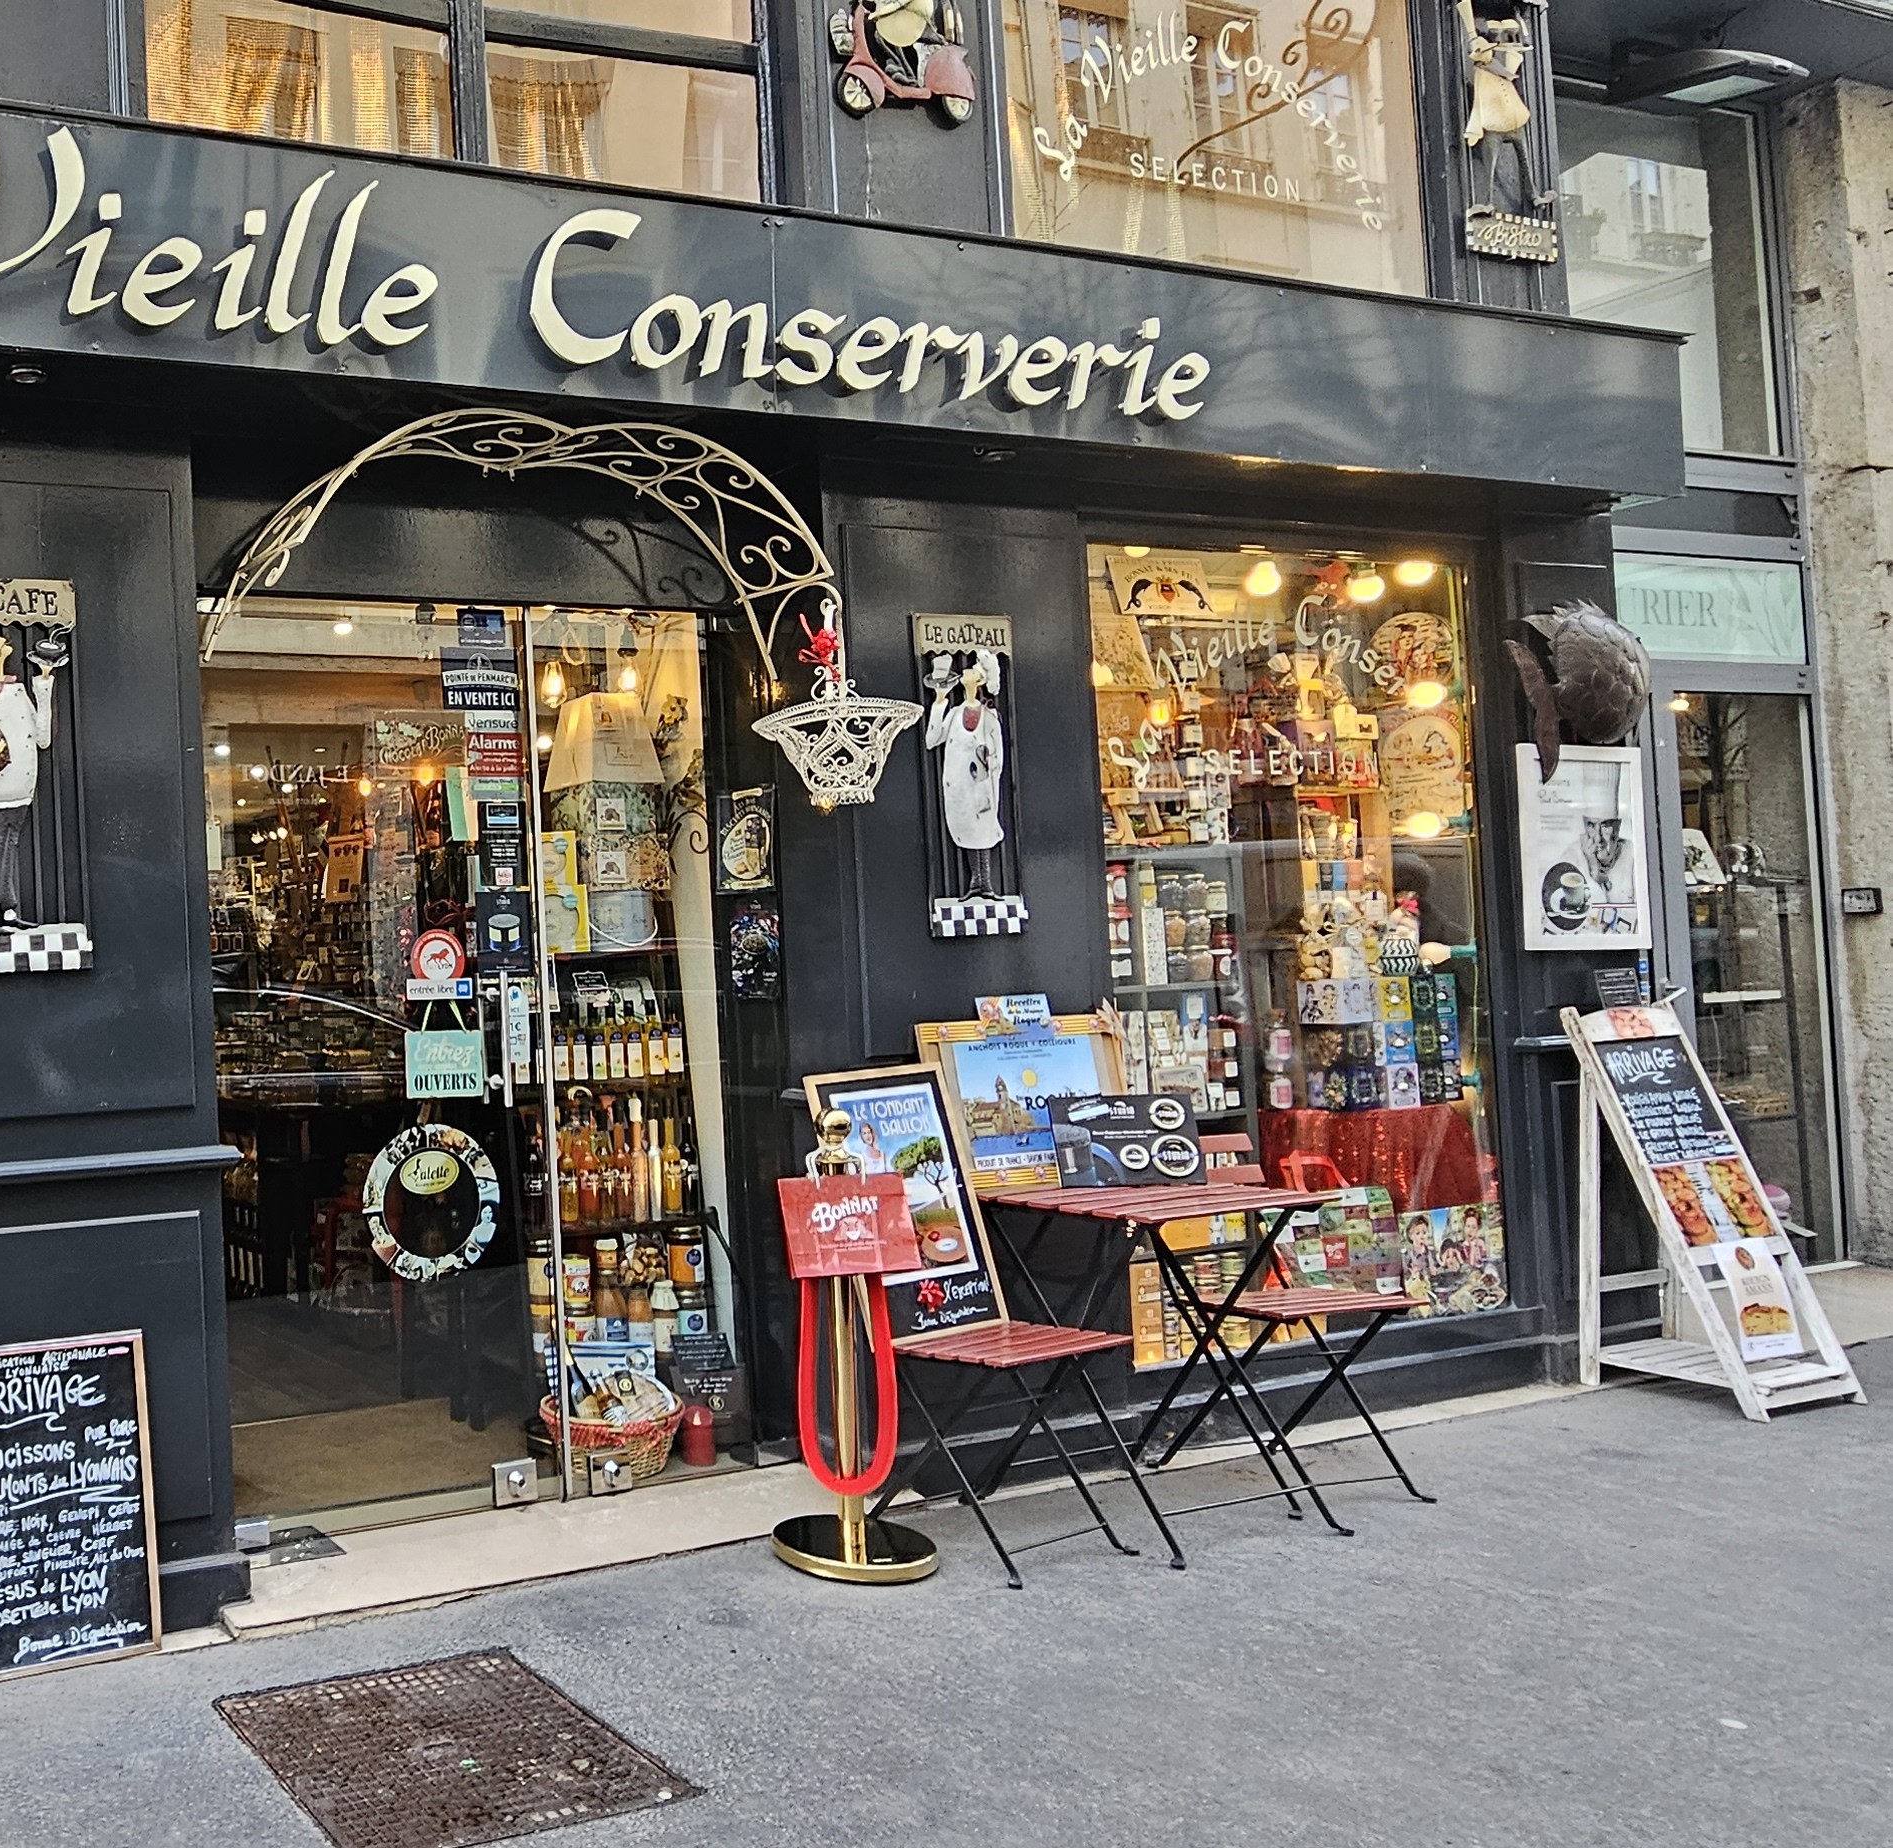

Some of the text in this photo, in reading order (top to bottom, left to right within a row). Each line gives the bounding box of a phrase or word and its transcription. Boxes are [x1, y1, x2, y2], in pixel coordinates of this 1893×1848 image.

[1033, 9, 1384, 231] La Vieille Conserverie
[1129, 152, 1301, 201] SELECTION
[1477, 221, 1543, 248] Bistro
[532, 209, 1212, 422] Conserverie
[924, 623, 1007, 647] LE GATEAU
[445, 673, 469, 684] POINTE
[447, 691, 516, 706] EN VENTE ICI
[1107, 717, 1166, 789] La
[1156, 612, 1275, 696] Vieille
[1204, 749, 1379, 776] SELECTION
[409, 984, 455, 995] entrée libre
[414, 1036, 476, 1064] Entrez
[414, 1072, 477, 1092] OUVERTS
[869, 1096, 927, 1120] FONDANT
[879, 1115, 933, 1138] BAULOIS
[811, 1195, 879, 1233] BONNAT
[61, 1565, 108, 1594] LYON
[62, 1587, 110, 1615] LYON
